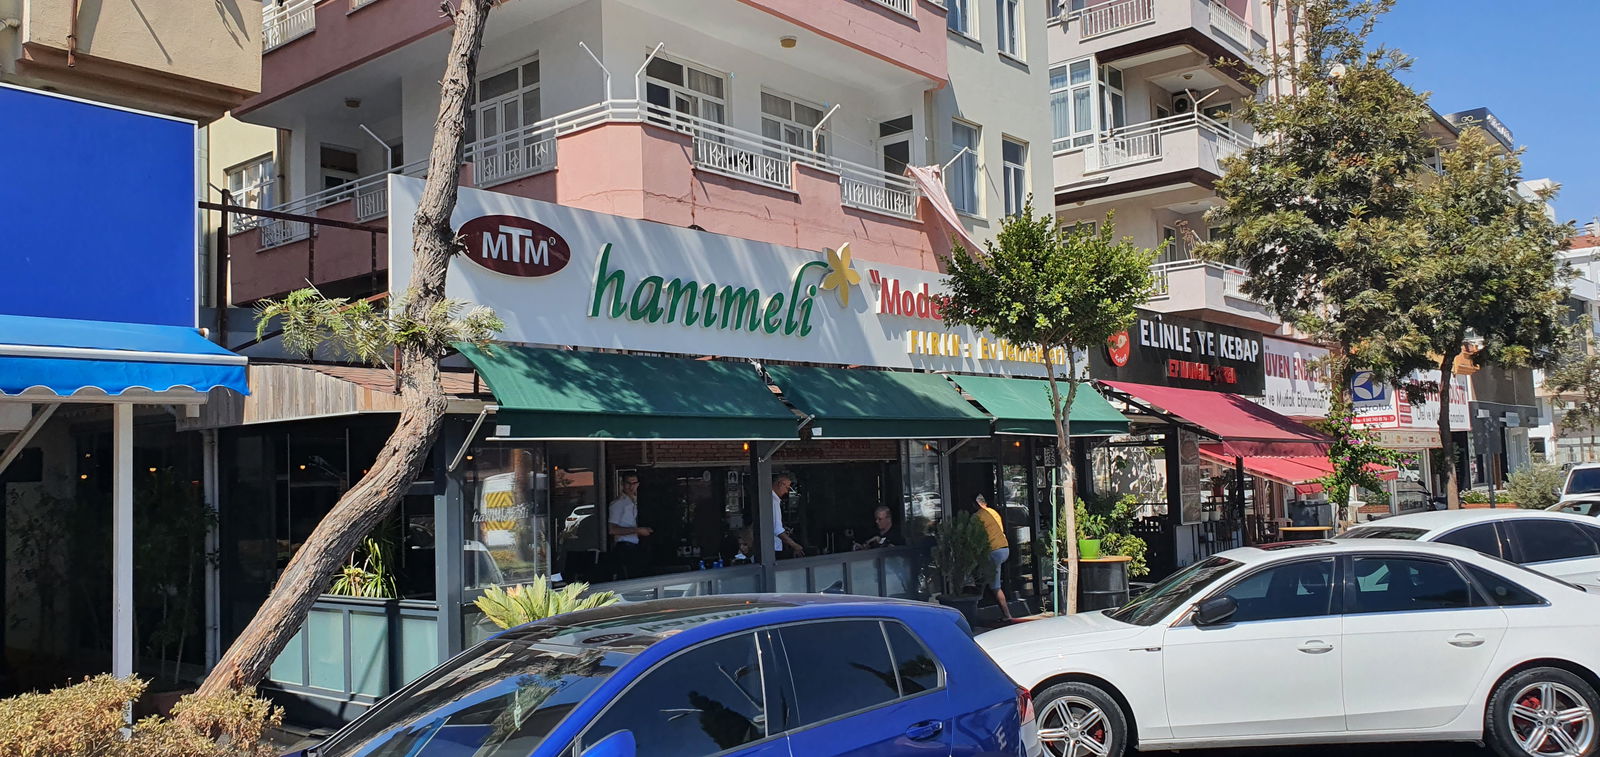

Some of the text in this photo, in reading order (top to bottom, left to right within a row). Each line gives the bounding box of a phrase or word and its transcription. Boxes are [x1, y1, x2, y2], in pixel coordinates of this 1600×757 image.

[482, 225, 550, 267] MTM
[588, 242, 829, 337] hanımeli
[978, 337, 997, 360] Ev
[1194, 330, 1216, 356] YE
[1219, 333, 1259, 363] KEBAP
[1264, 344, 1291, 379] ÜVEN
